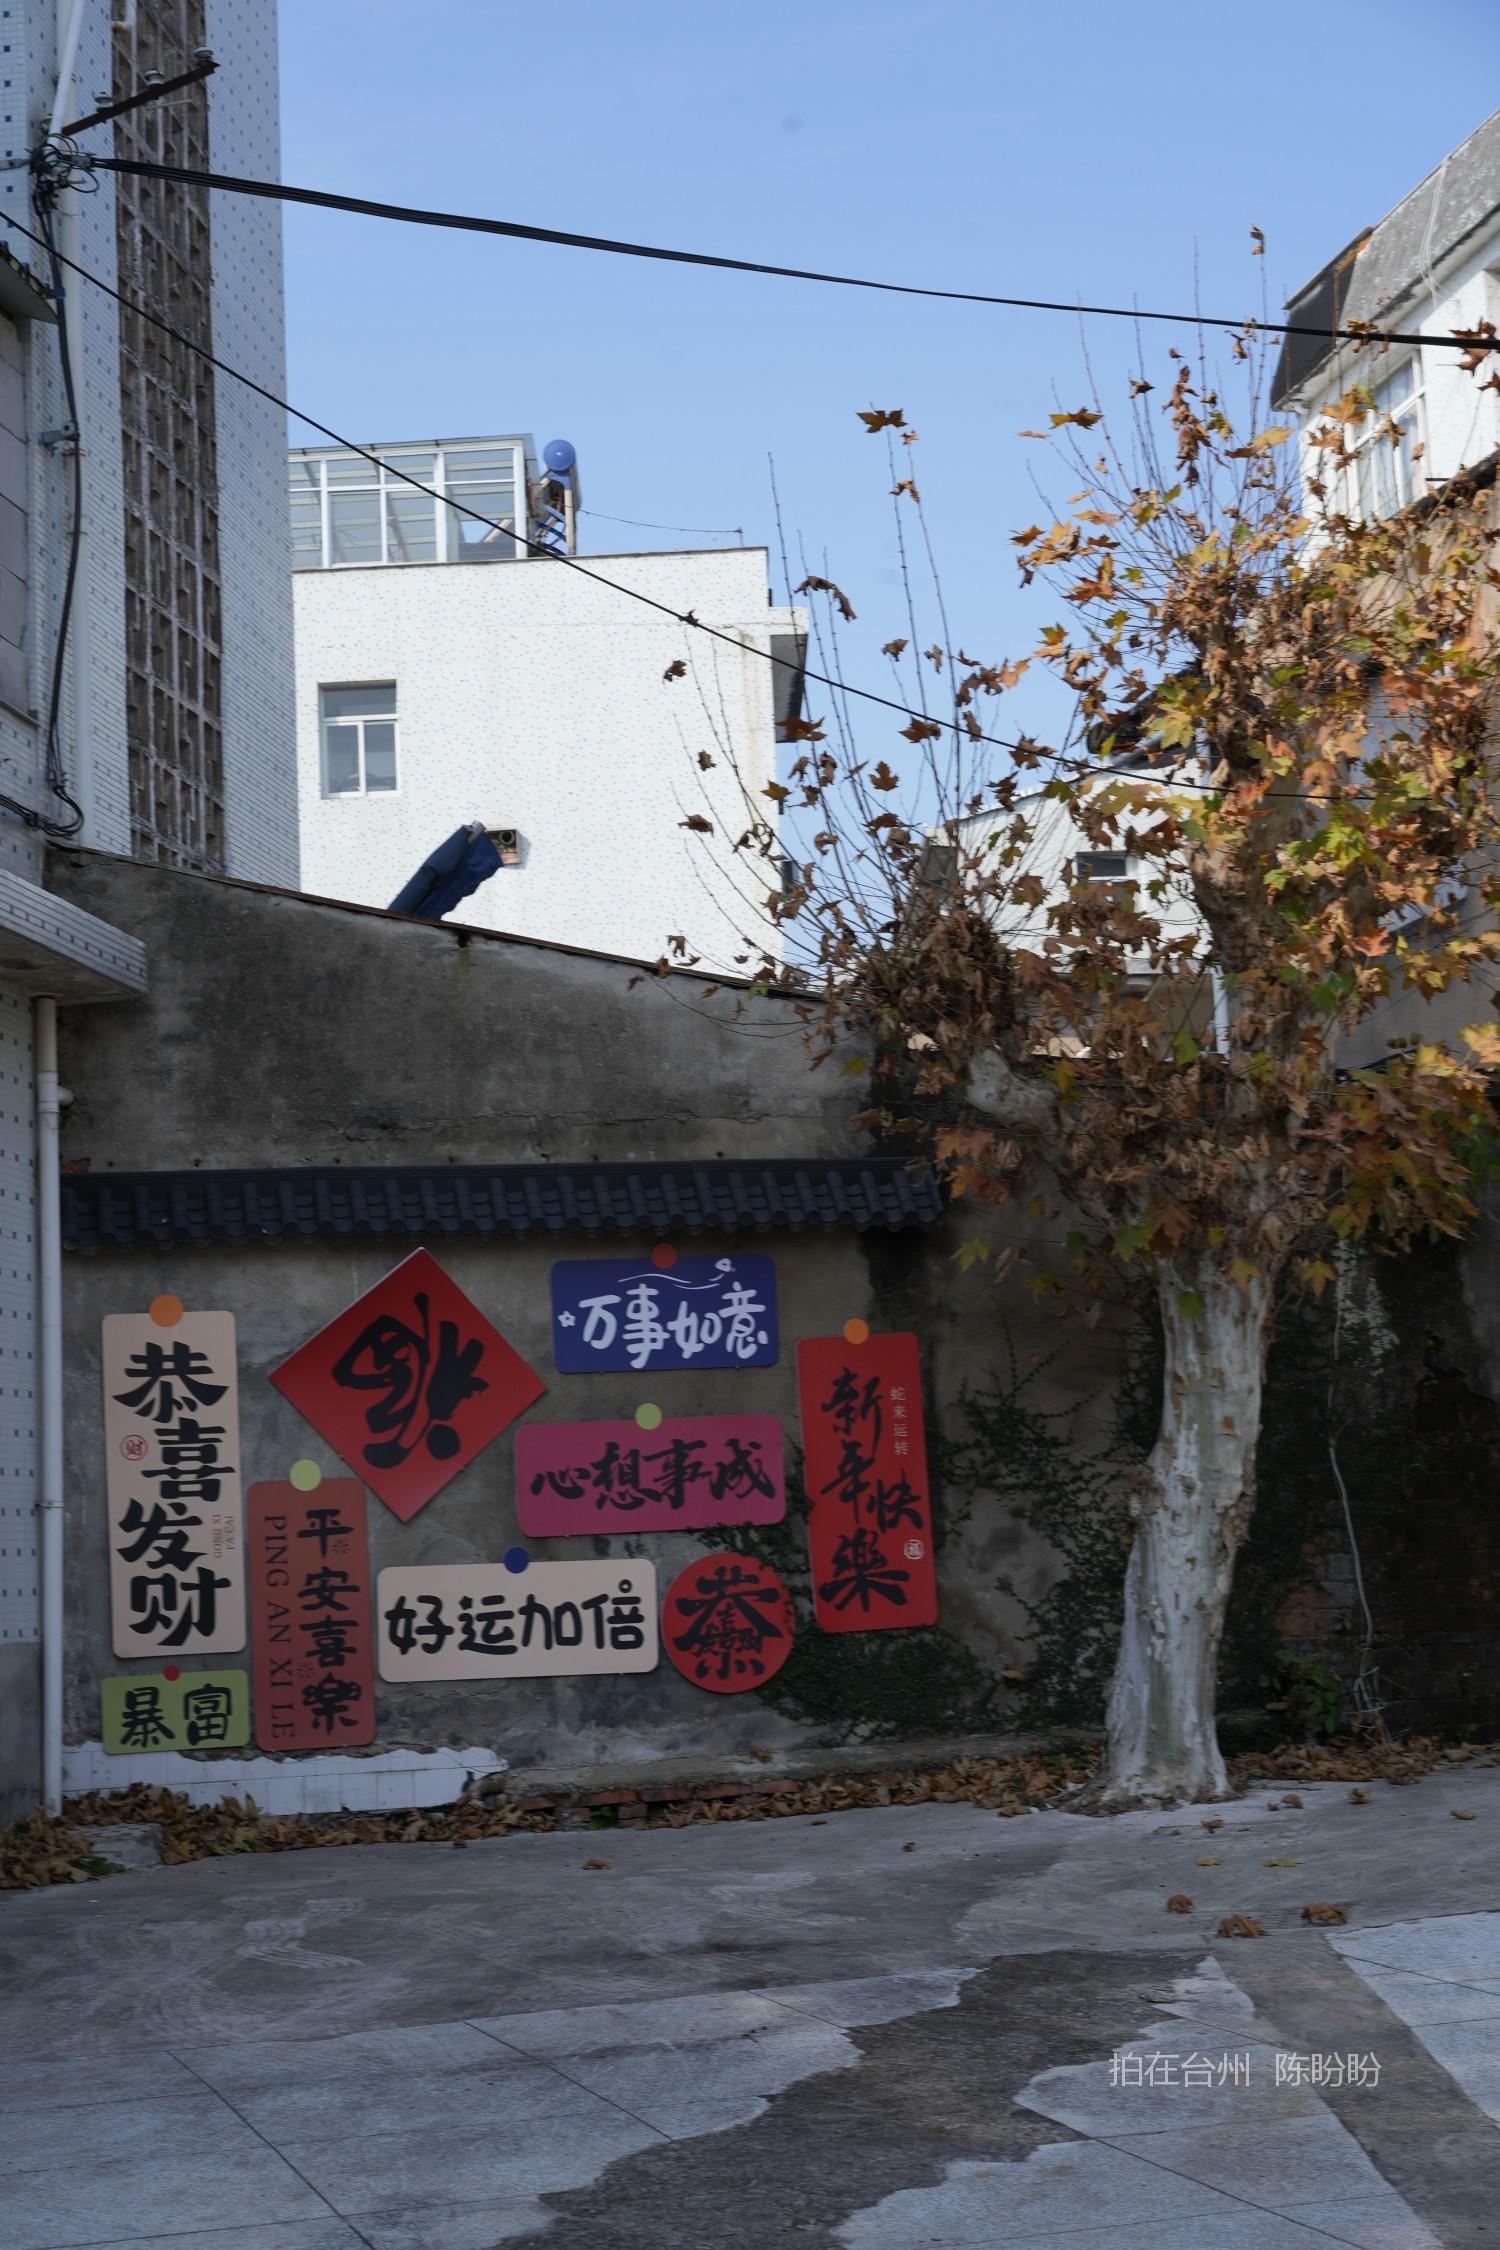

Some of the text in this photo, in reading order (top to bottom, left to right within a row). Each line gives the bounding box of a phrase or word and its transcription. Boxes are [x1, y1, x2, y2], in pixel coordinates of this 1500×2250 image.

[579, 1280, 769, 1369] 万事如意
[331, 1292, 490, 1469] 福
[112, 1340, 236, 1648] 恭喜发财
[531, 1438, 777, 1511] 心想事成
[263, 1514, 295, 1740] PING AN XI LE
[384, 1579, 645, 1656] 好运加倍
[120, 1683, 233, 1748] 暴富
